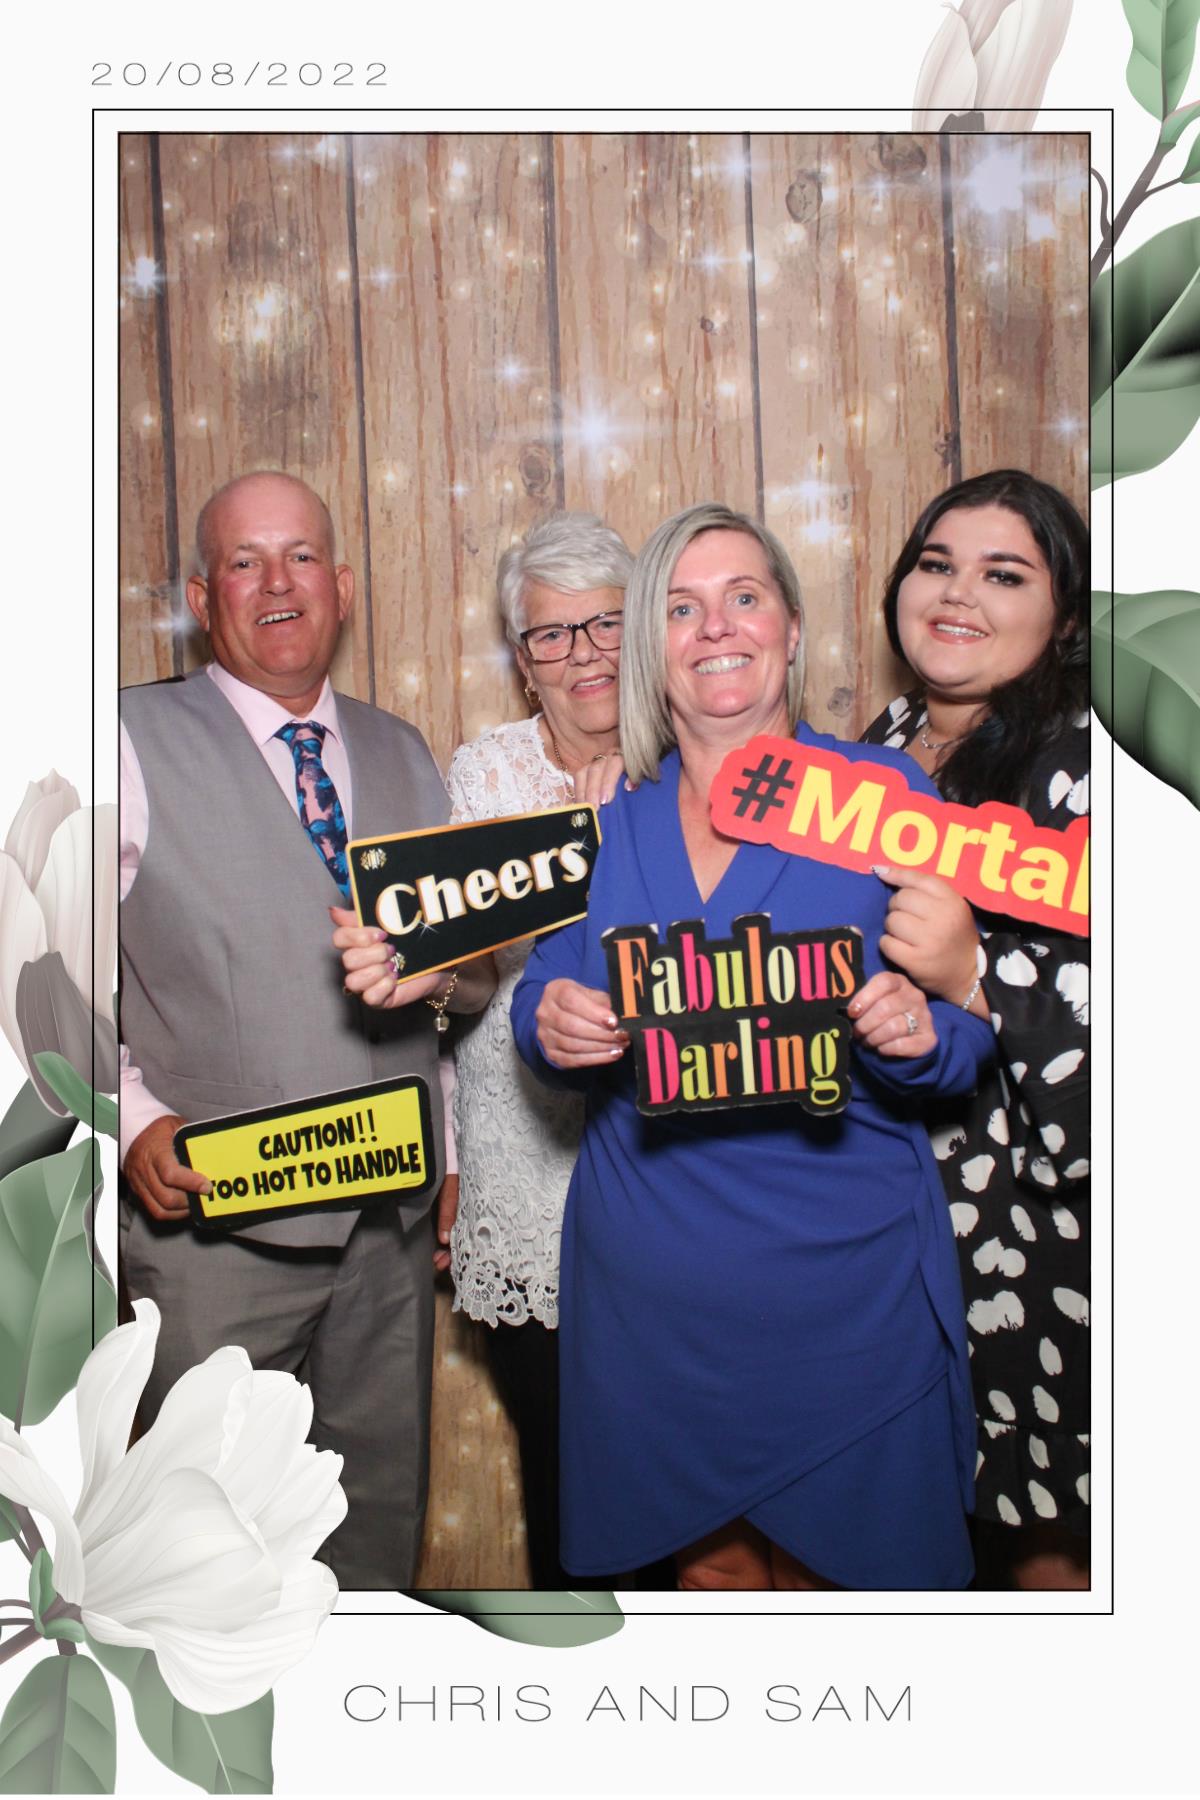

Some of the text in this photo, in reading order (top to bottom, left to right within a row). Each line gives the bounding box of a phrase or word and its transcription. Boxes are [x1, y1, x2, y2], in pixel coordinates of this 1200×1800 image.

[376, 841, 589, 936] Cheers
[613, 926, 856, 1019] Fabulous
[641, 1016, 841, 1105] Darling
[253, 1165, 297, 1196] HOT
[301, 1161, 331, 1188] TO
[334, 1142, 422, 1185] HANDLE
[258, 1109, 378, 1160] CAUTION!!
